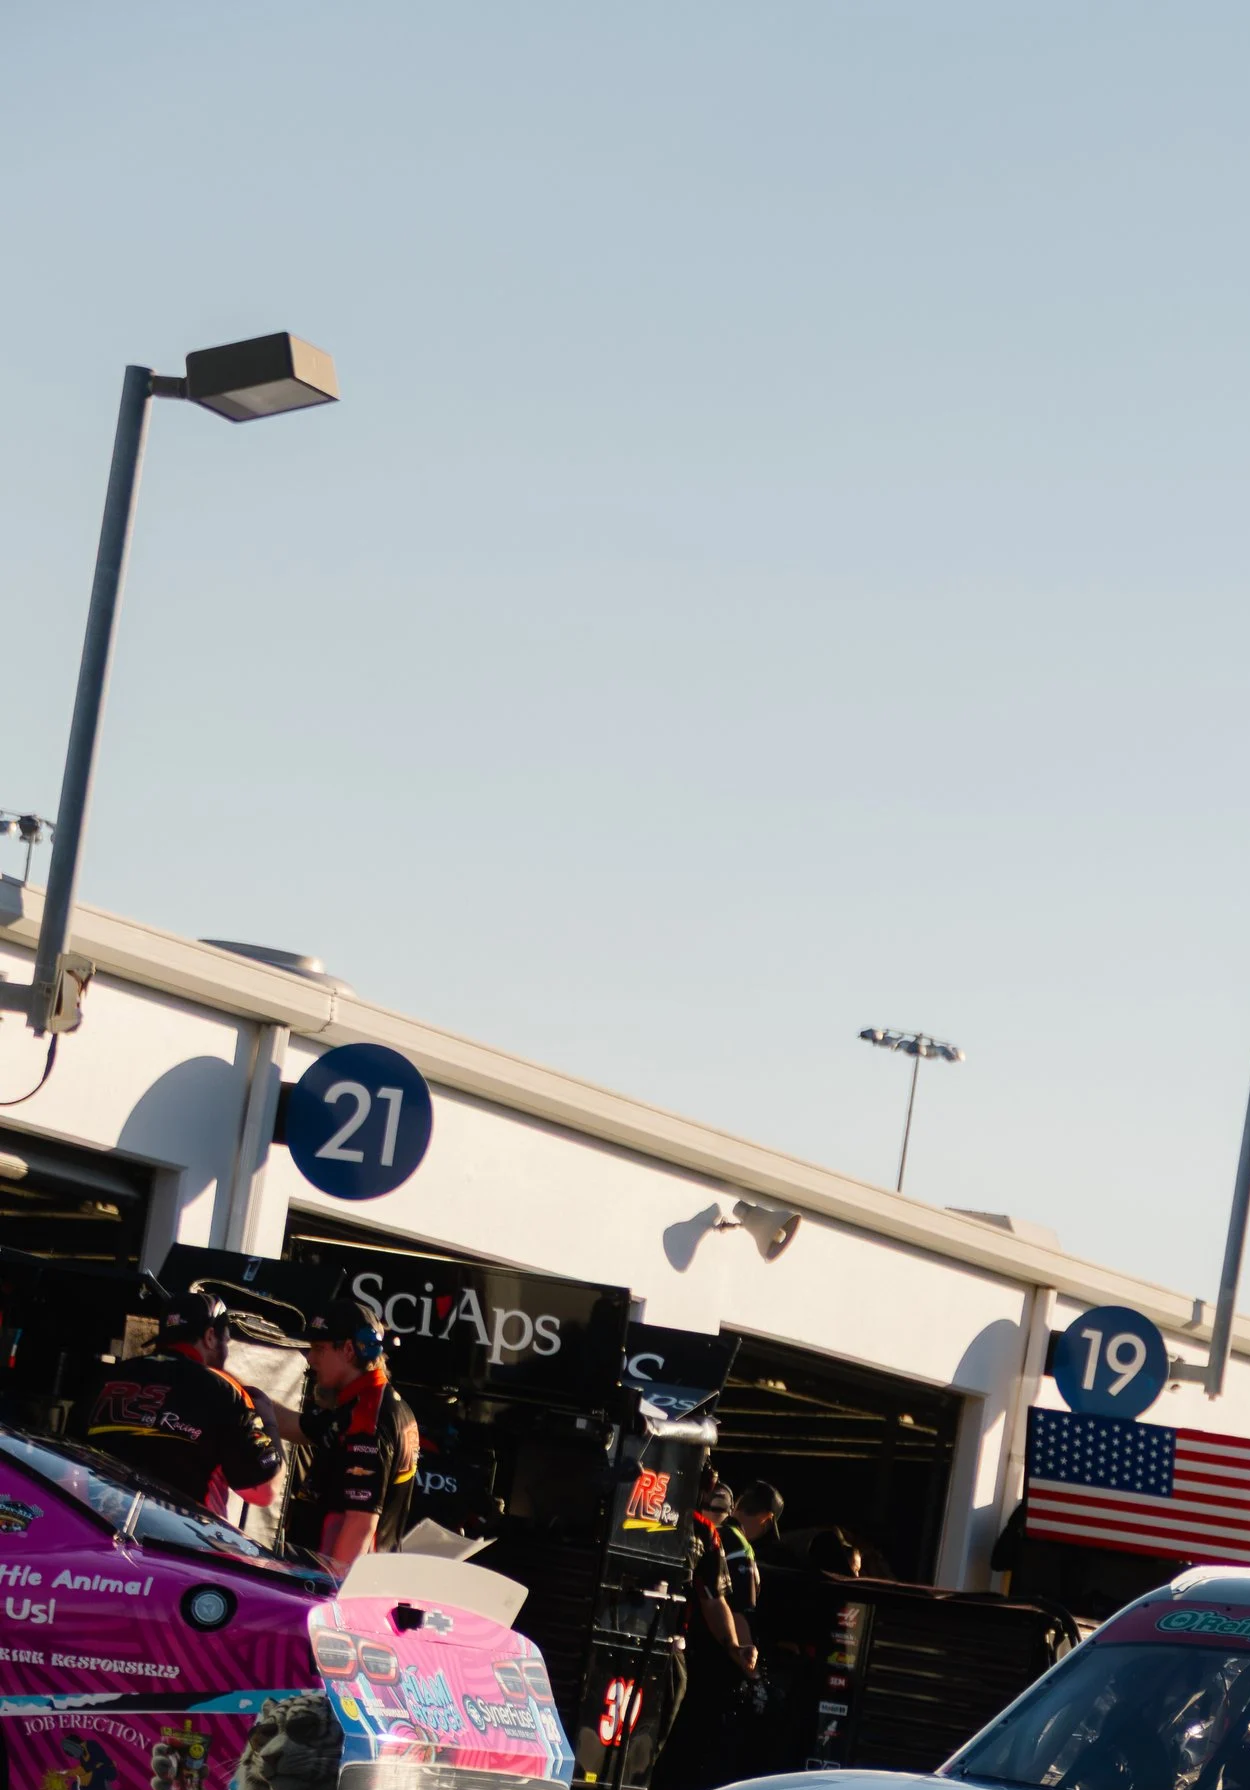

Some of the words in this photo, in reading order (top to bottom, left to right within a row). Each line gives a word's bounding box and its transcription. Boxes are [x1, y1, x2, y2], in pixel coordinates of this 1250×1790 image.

[316, 1081, 405, 1167] 21
[1081, 1328, 1147, 1397] 19
[51, 1569, 154, 1596] Animal
[51, 1652, 180, 1679] RESPONSIBLY
[24, 1715, 56, 1736] JOB
[58, 1714, 151, 1750] ERECTION
